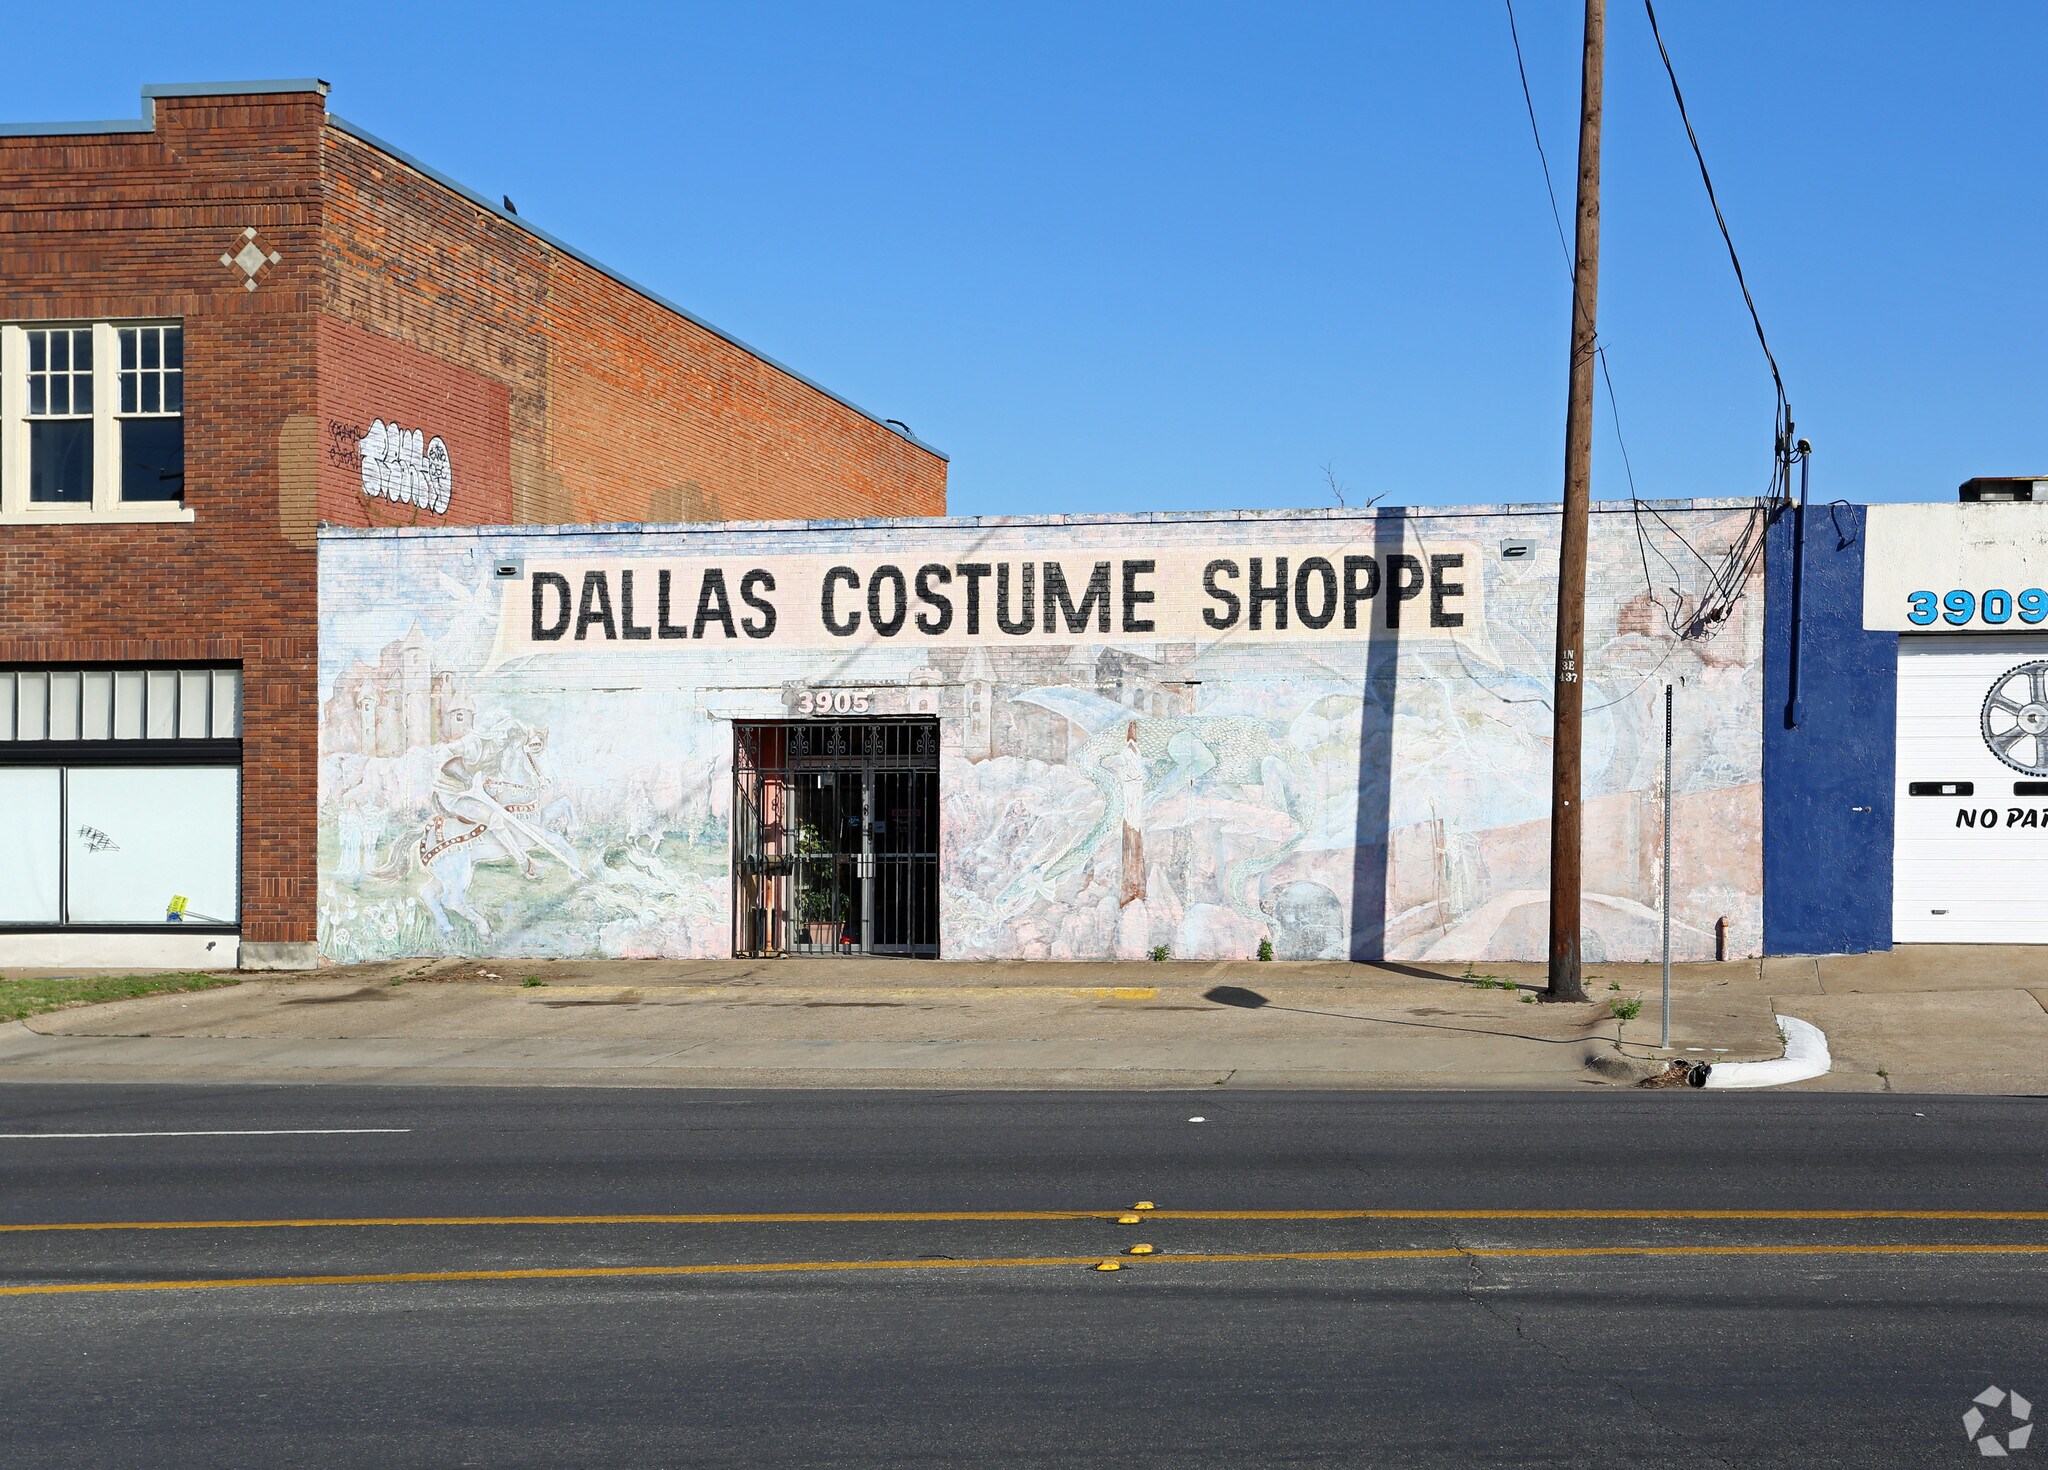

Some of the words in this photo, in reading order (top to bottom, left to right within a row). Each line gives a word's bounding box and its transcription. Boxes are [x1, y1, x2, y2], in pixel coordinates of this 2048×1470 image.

[531, 567, 777, 641] DALLAS
[820, 558, 1156, 637] COSTUME
[1202, 553, 1464, 631] SHOPPE
[1907, 588, 2048, 626] 3909
[1561, 660, 1575, 671] 3E
[798, 690, 869, 714] 3905
[1955, 808, 1998, 829] NO
